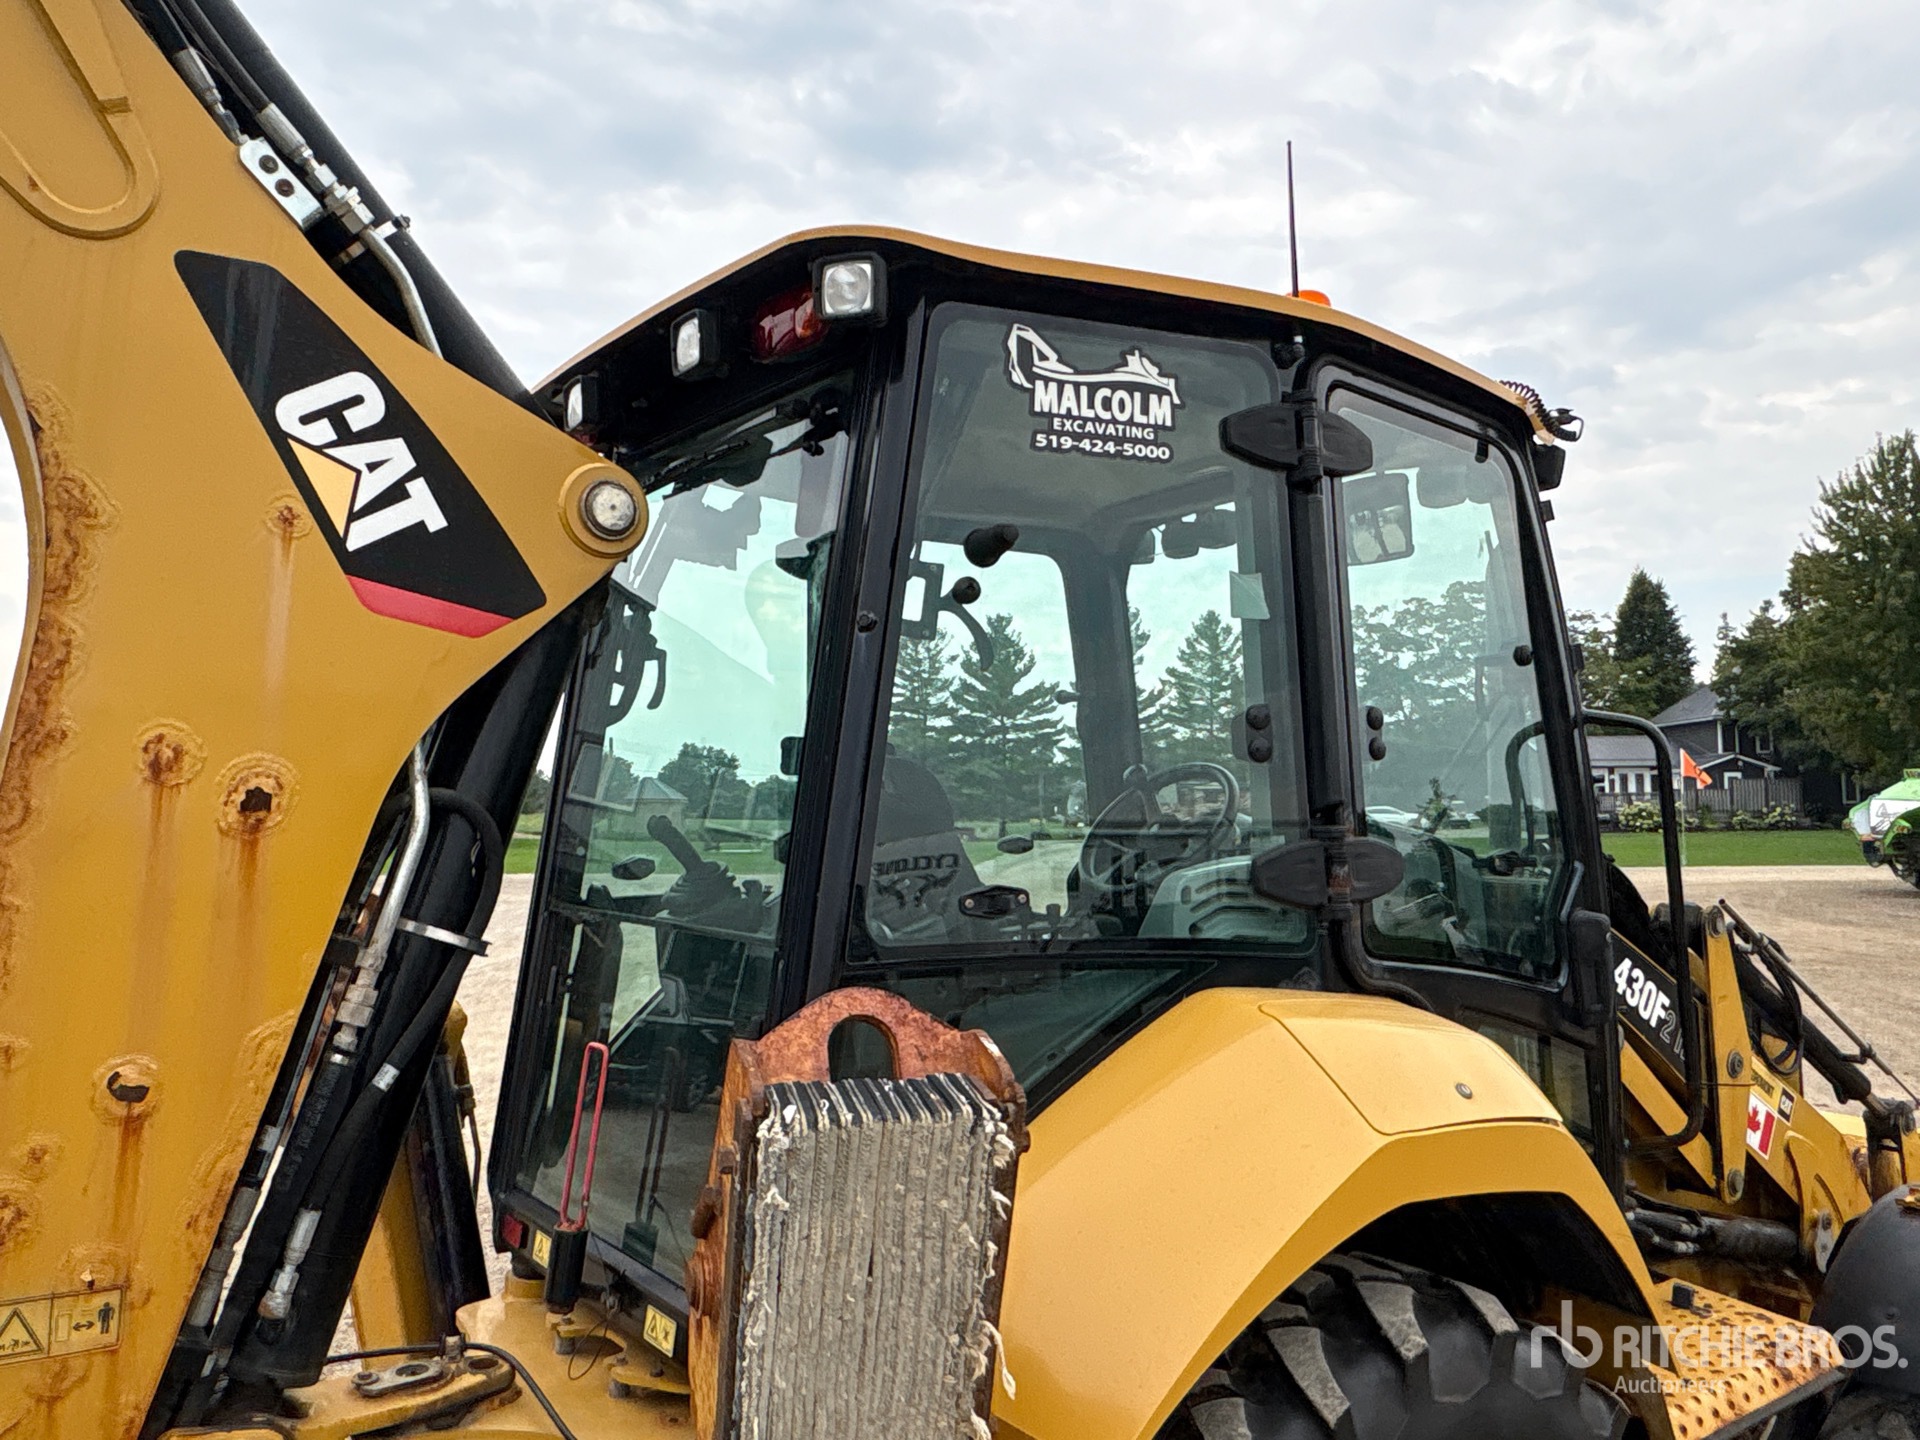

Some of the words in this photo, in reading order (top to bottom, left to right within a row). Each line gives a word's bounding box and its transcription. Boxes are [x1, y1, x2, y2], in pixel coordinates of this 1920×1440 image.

[1033, 379, 1173, 426] MALCOLM
[1035, 433, 1170, 459] 519-424-5000
[1053, 417, 1154, 440] EXCAVATING
[275, 371, 449, 552] CAT
